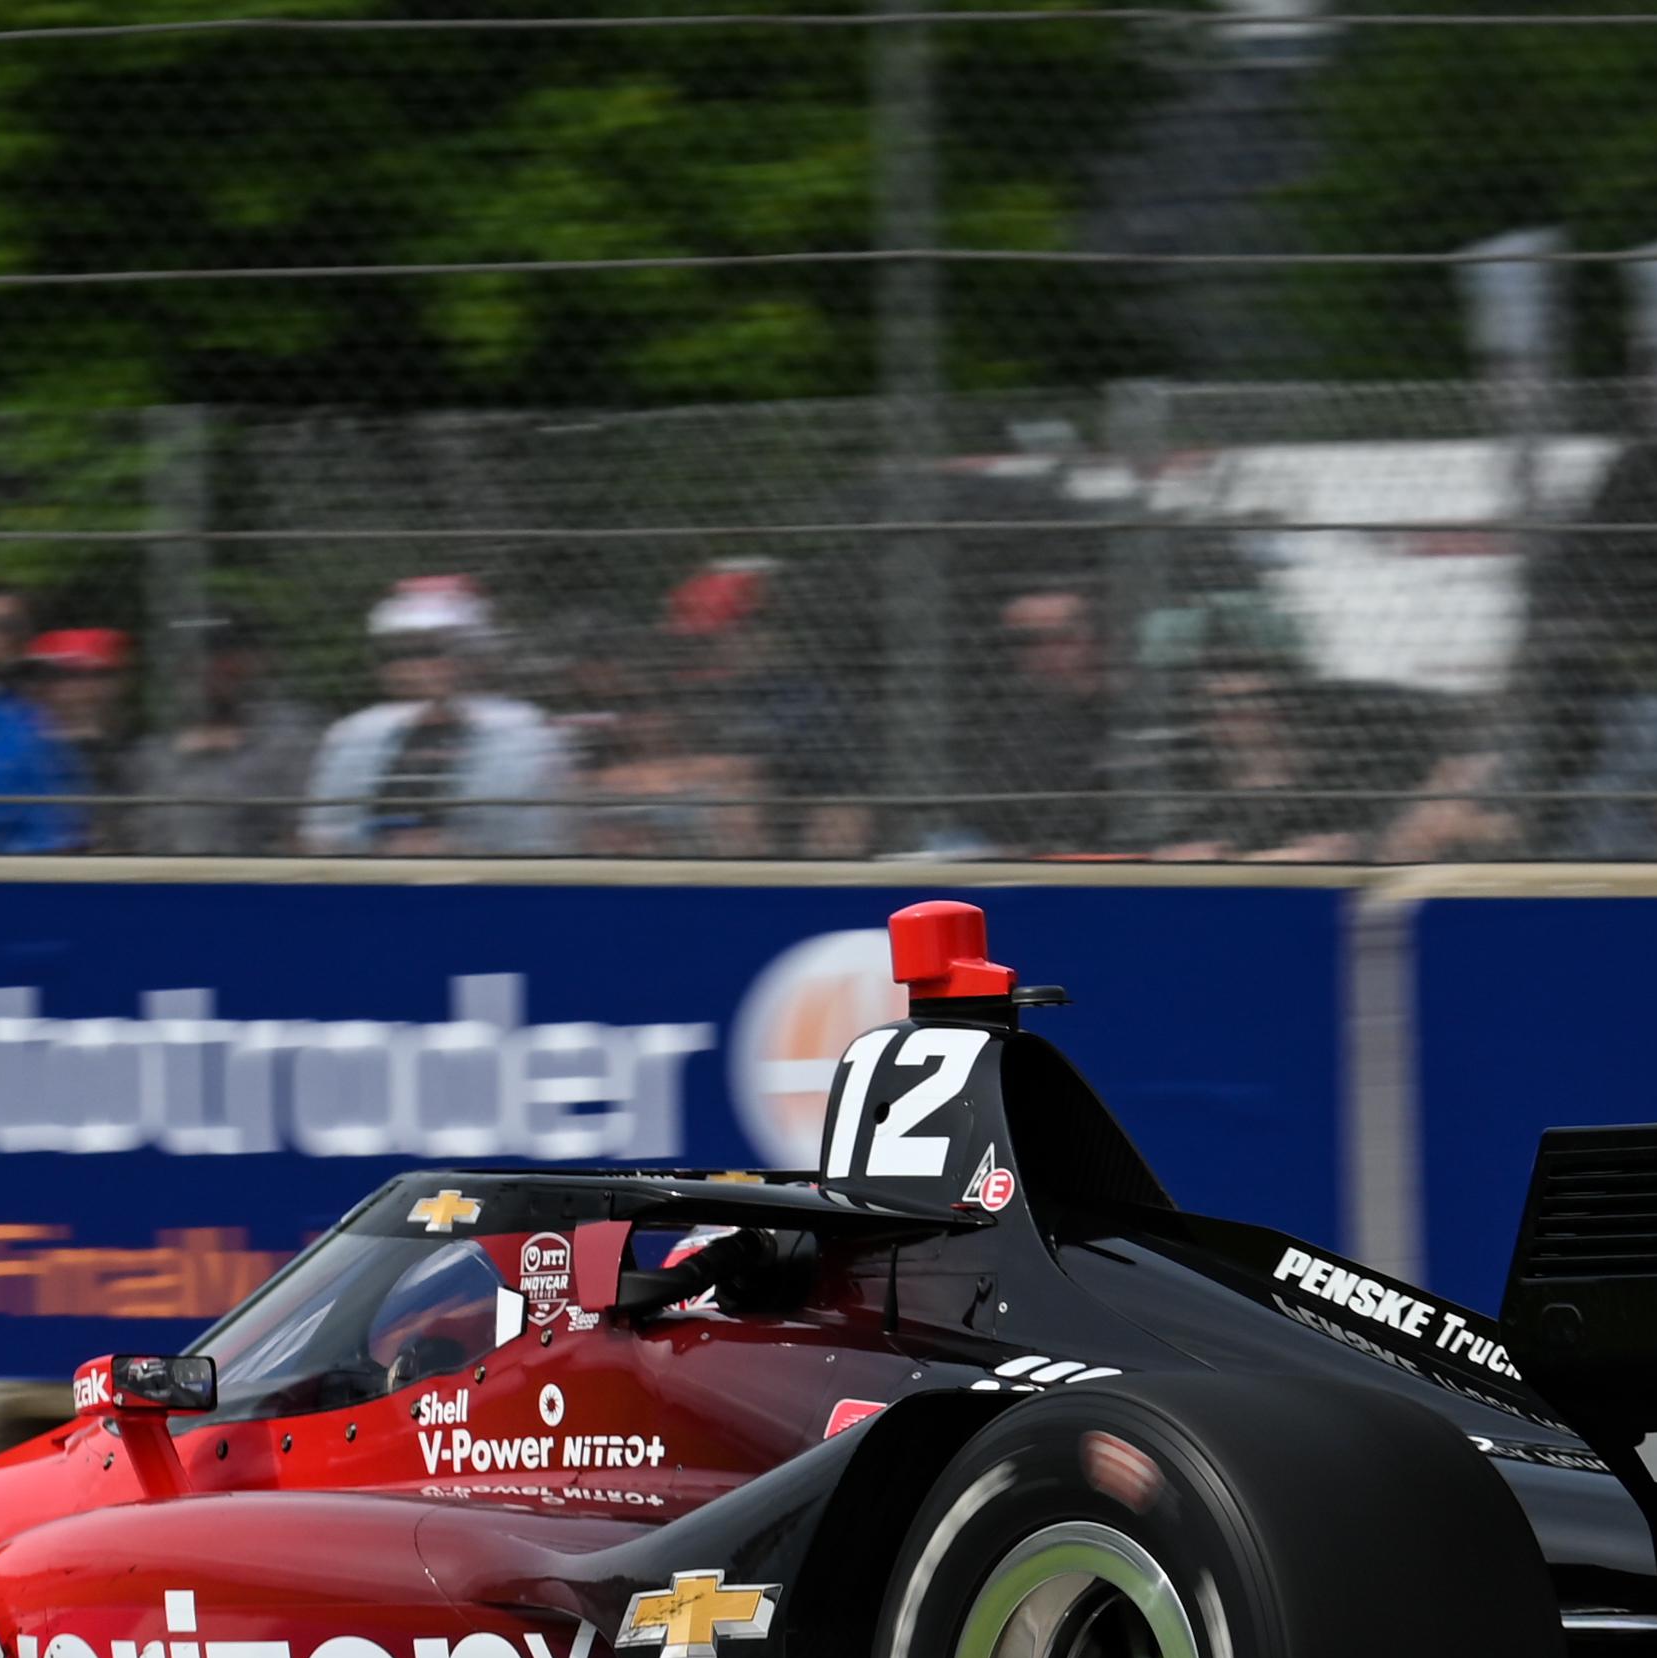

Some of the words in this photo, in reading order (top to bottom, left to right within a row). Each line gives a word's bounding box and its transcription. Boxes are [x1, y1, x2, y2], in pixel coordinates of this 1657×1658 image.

[827, 1028, 991, 1179] 12
[542, 1249, 566, 1266] NTT
[520, 1274, 569, 1291] INDYCAR
[1273, 1247, 1436, 1339] PENSKE
[419, 1388, 469, 1426] Shell
[418, 1428, 554, 1475] V-Power
